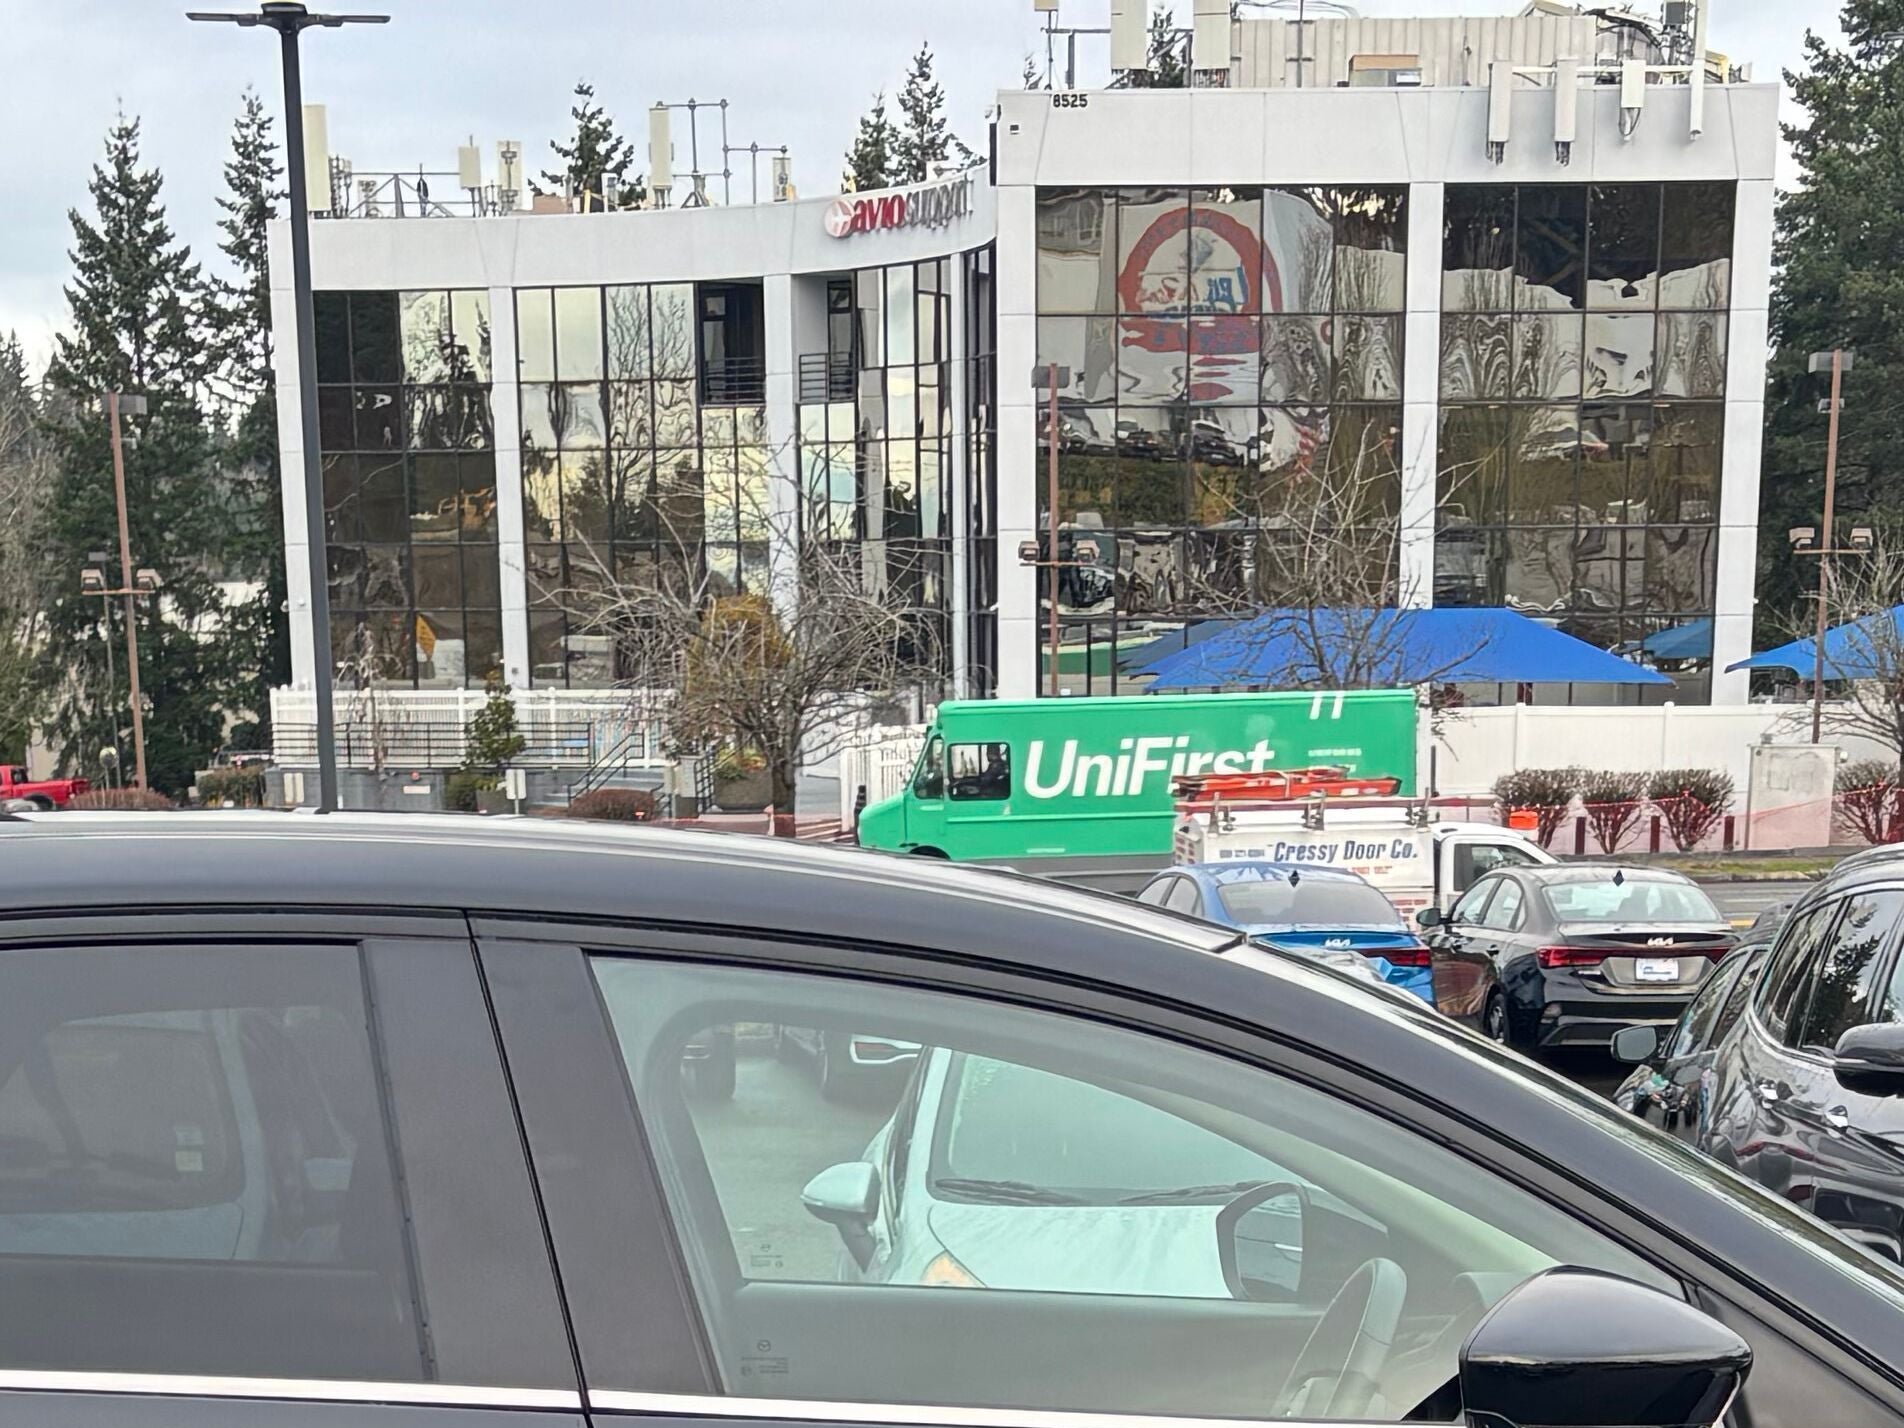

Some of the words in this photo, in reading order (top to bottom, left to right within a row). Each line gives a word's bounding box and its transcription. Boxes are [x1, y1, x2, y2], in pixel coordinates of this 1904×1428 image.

[1053, 93, 1088, 108] 8525
[1024, 736, 1275, 799] UniFirst
[1274, 841, 1339, 864] Cressy
[1343, 840, 1386, 860] Door
[1390, 839, 1418, 859] Co.
